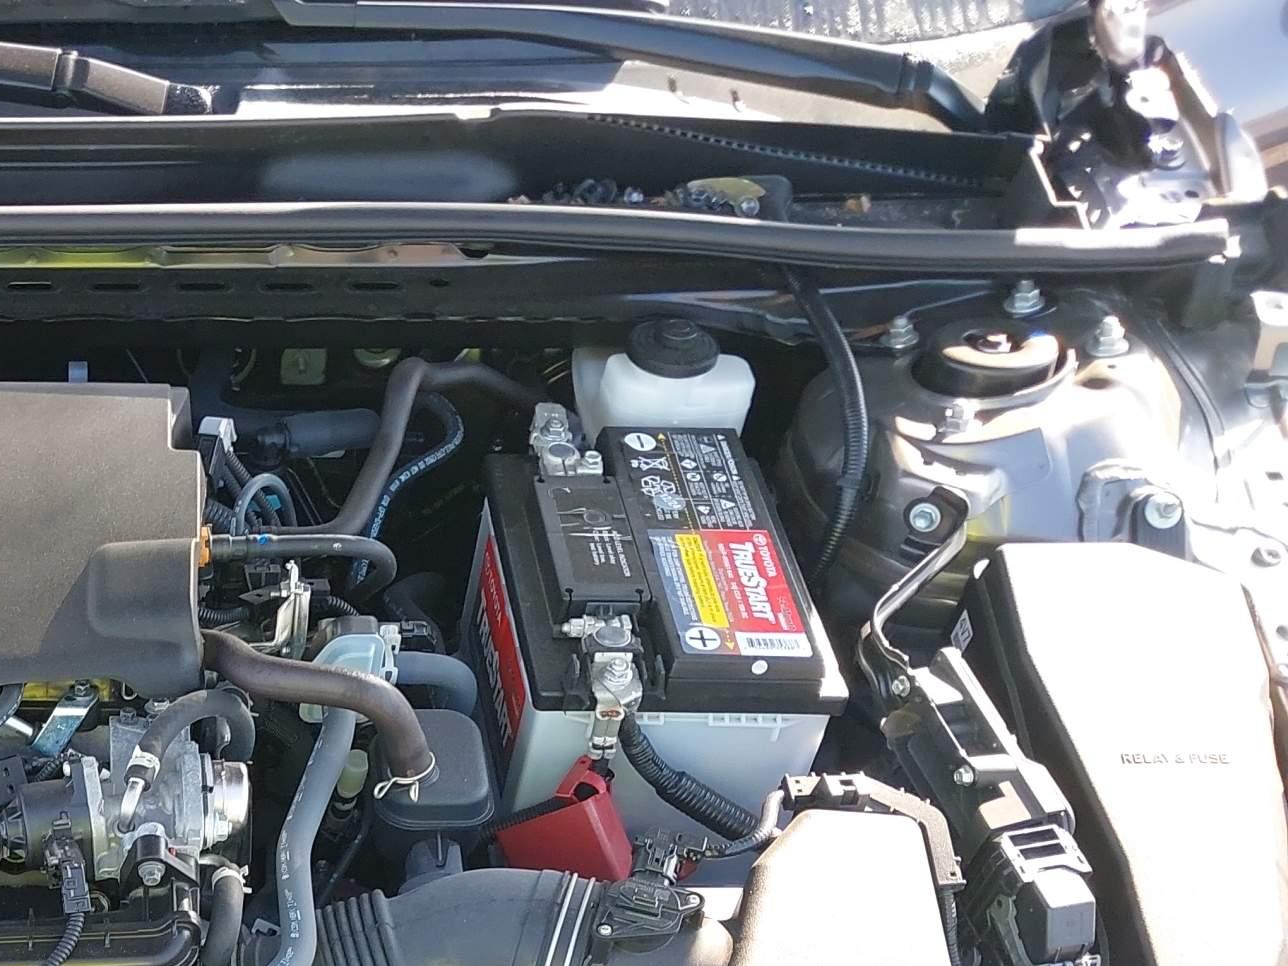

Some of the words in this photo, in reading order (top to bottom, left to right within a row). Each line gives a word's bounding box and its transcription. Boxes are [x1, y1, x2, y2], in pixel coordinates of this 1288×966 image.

[758, 546, 778, 577] TOYOTA
[1120, 753, 1170, 765] RELAY
[1174, 753, 1185, 764] &
[1188, 753, 1231, 765] FUSE
